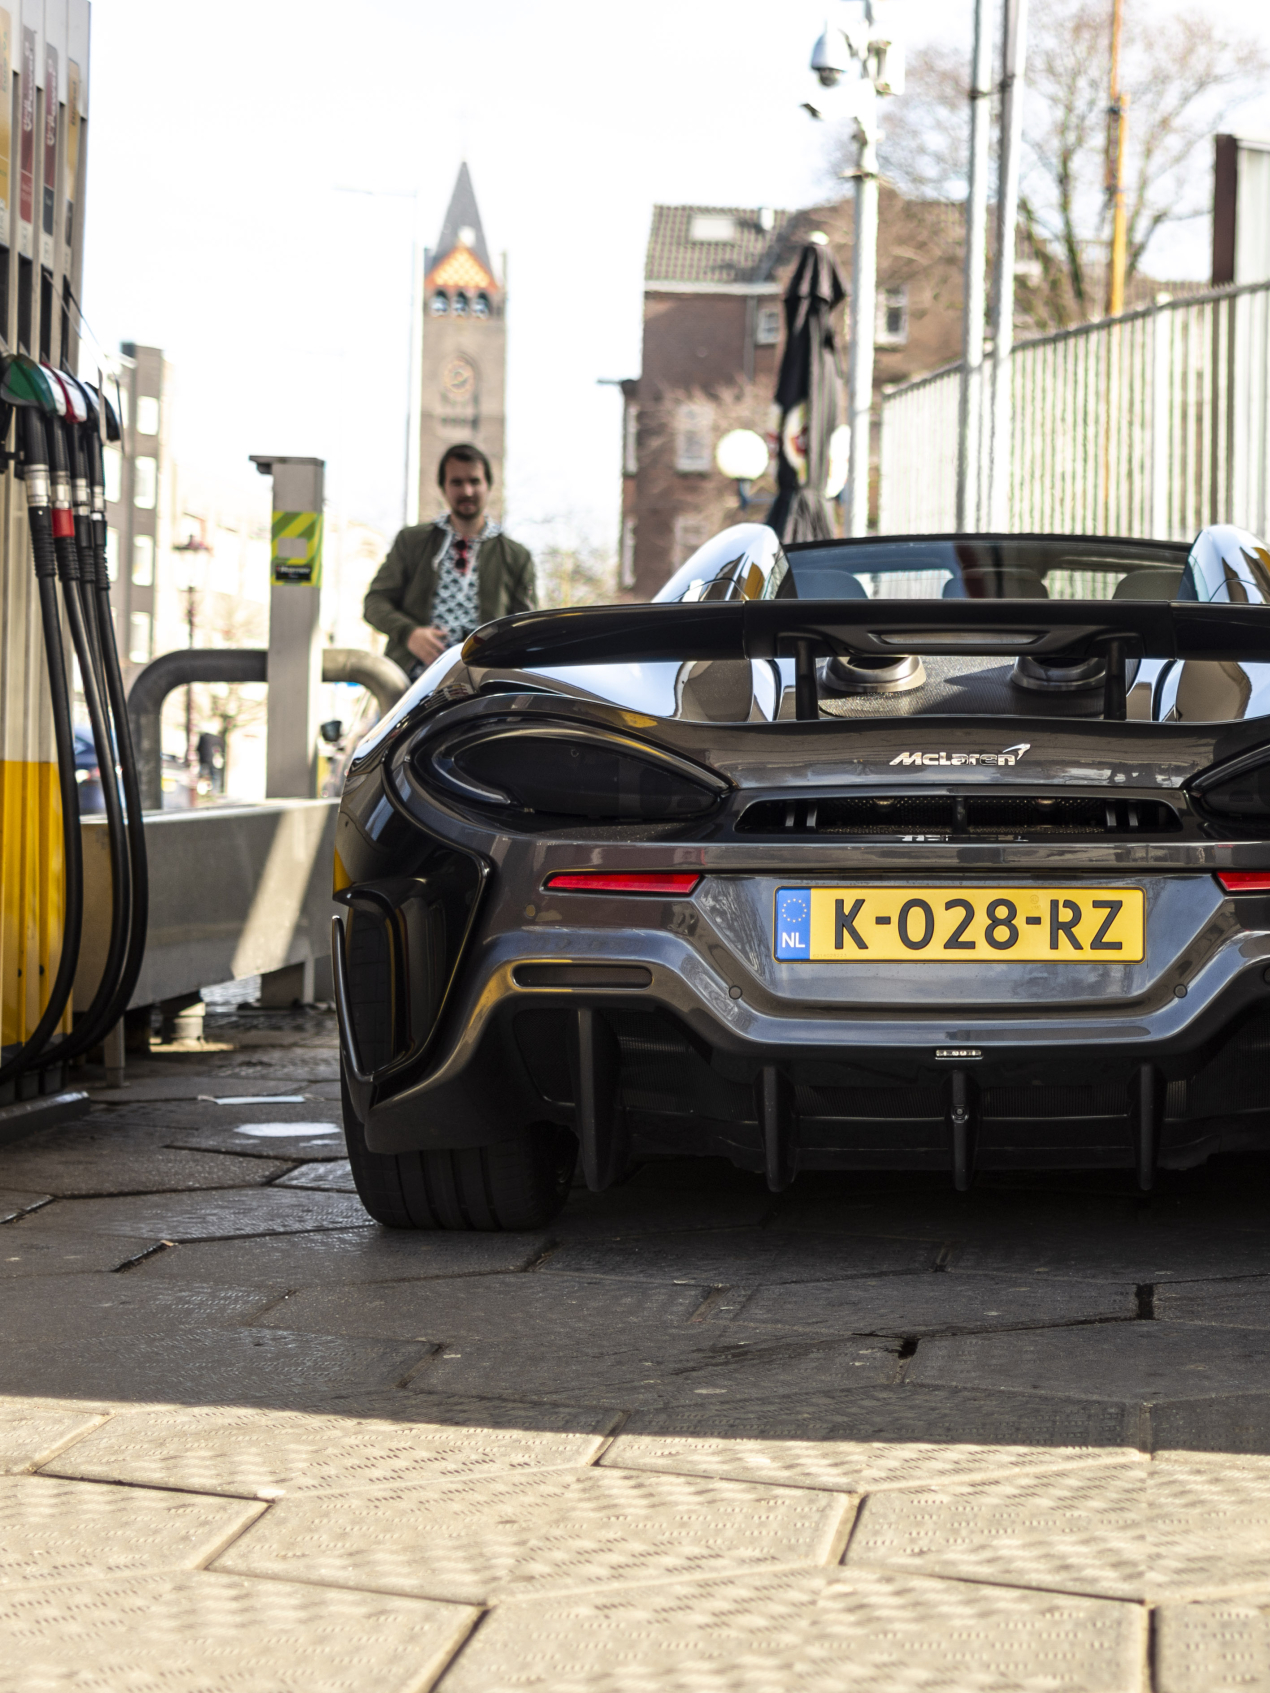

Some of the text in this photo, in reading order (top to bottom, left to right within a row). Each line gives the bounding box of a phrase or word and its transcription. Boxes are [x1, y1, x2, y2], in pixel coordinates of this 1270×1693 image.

[889, 752, 1016, 765] McLaren
[834, 898, 1124, 951] K-028-RZ
[781, 932, 806, 948] NL
